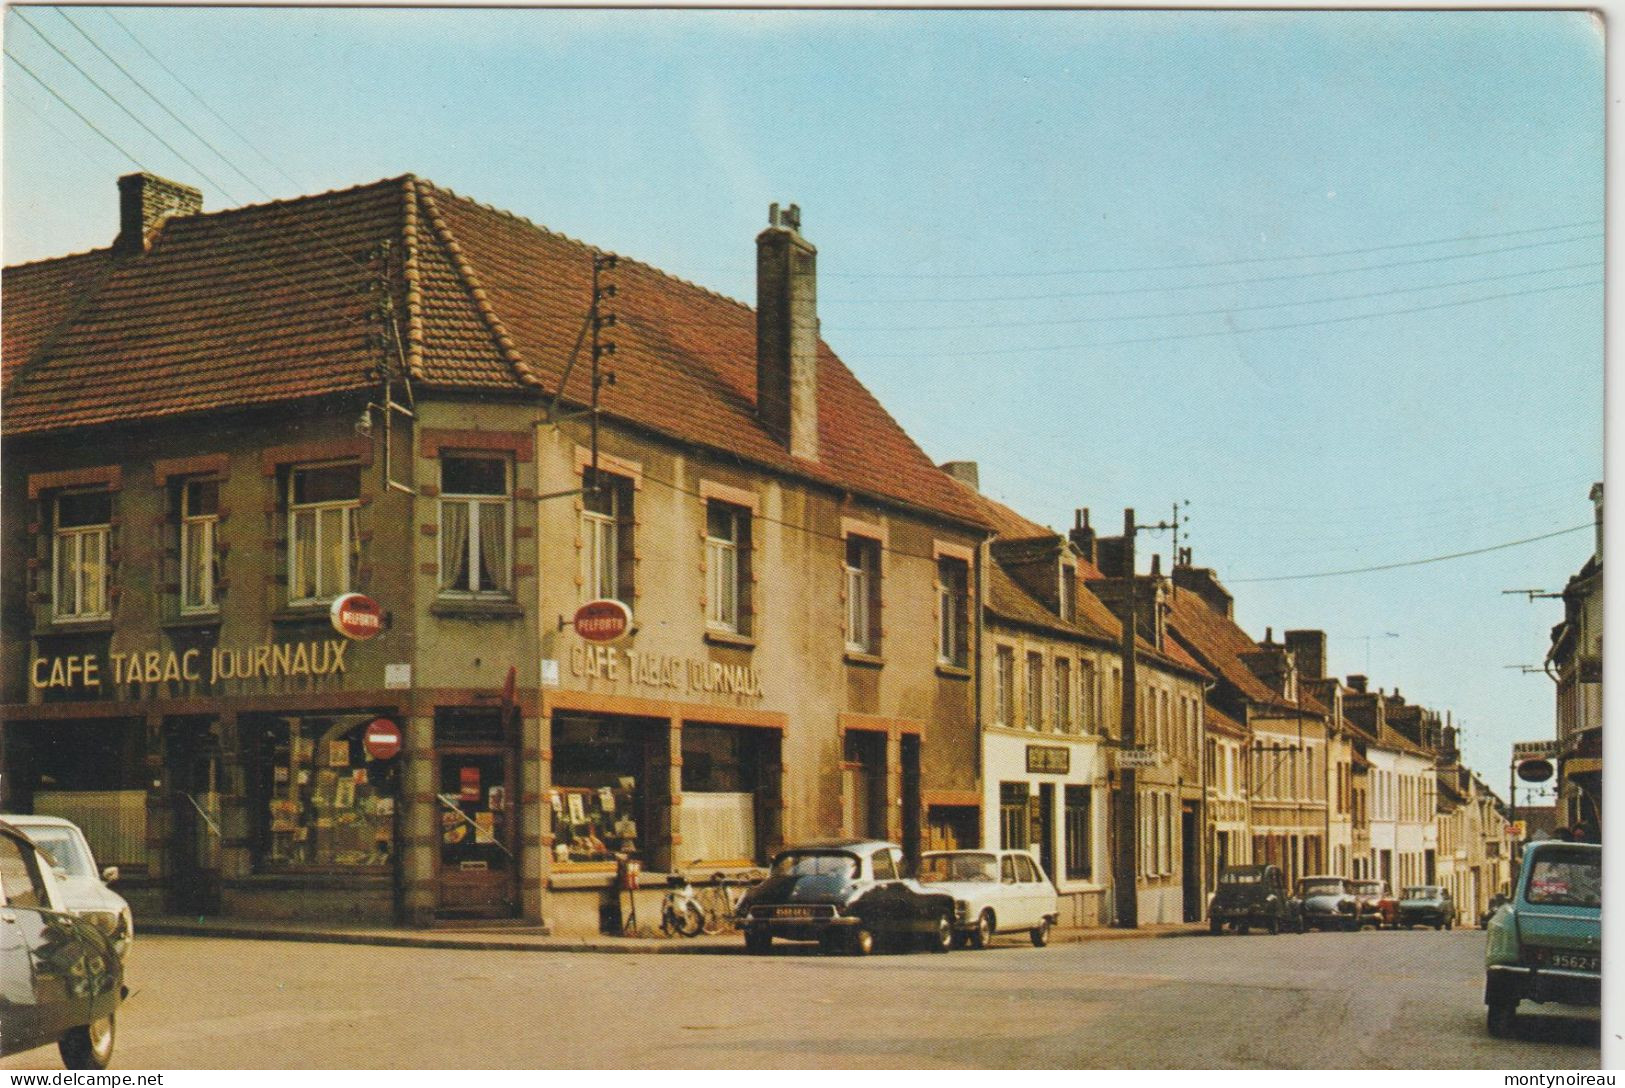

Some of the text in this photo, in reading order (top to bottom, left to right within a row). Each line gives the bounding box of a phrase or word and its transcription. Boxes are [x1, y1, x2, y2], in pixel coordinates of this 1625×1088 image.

[110, 649, 199, 684] TABAC
[210, 640, 347, 685] JOURNAUX
[625, 648, 679, 689] TABAC
[685, 656, 763, 699] JOURNAUX
